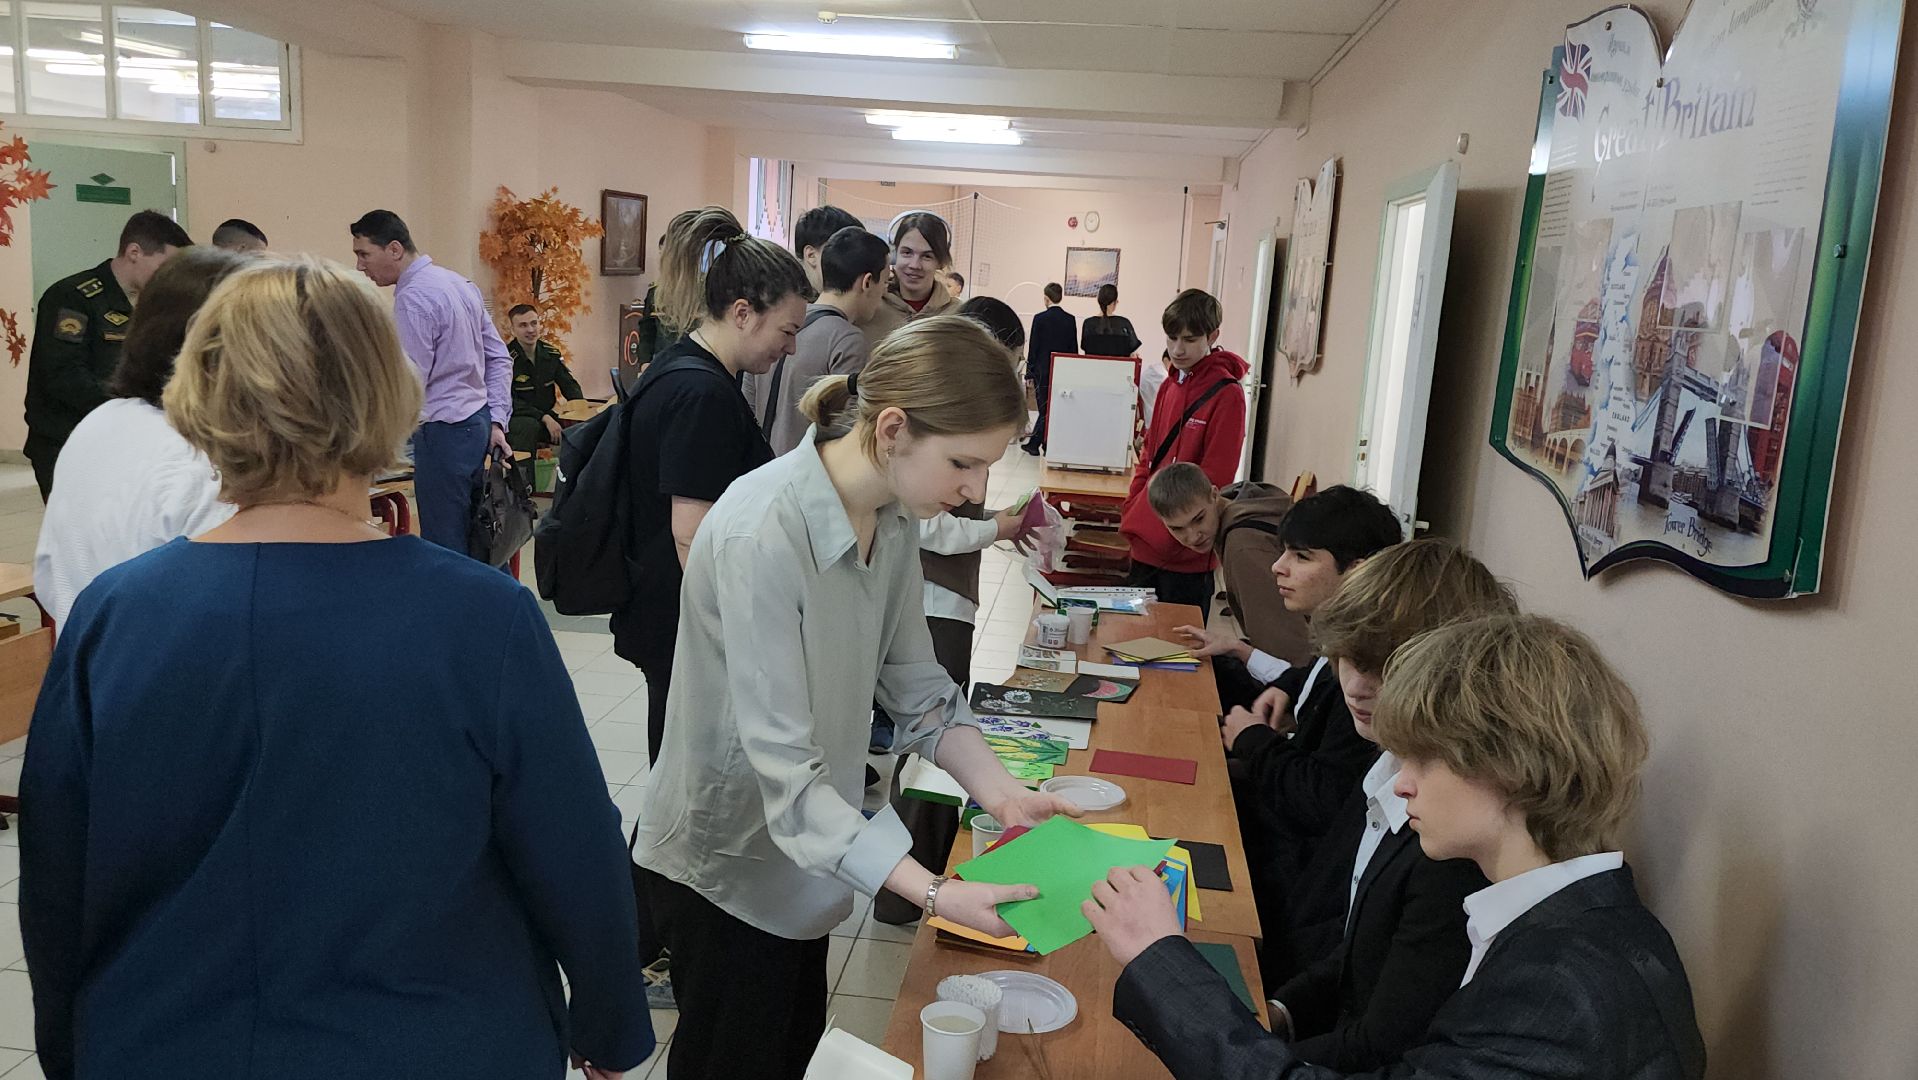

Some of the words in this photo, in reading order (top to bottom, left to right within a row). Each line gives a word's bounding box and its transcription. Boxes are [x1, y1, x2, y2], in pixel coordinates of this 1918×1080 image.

[1591, 86, 1656, 192] Great
[1653, 77, 1757, 151] Britain
[1664, 512, 1686, 536] Tower
[1687, 516, 1713, 557] Bridge
